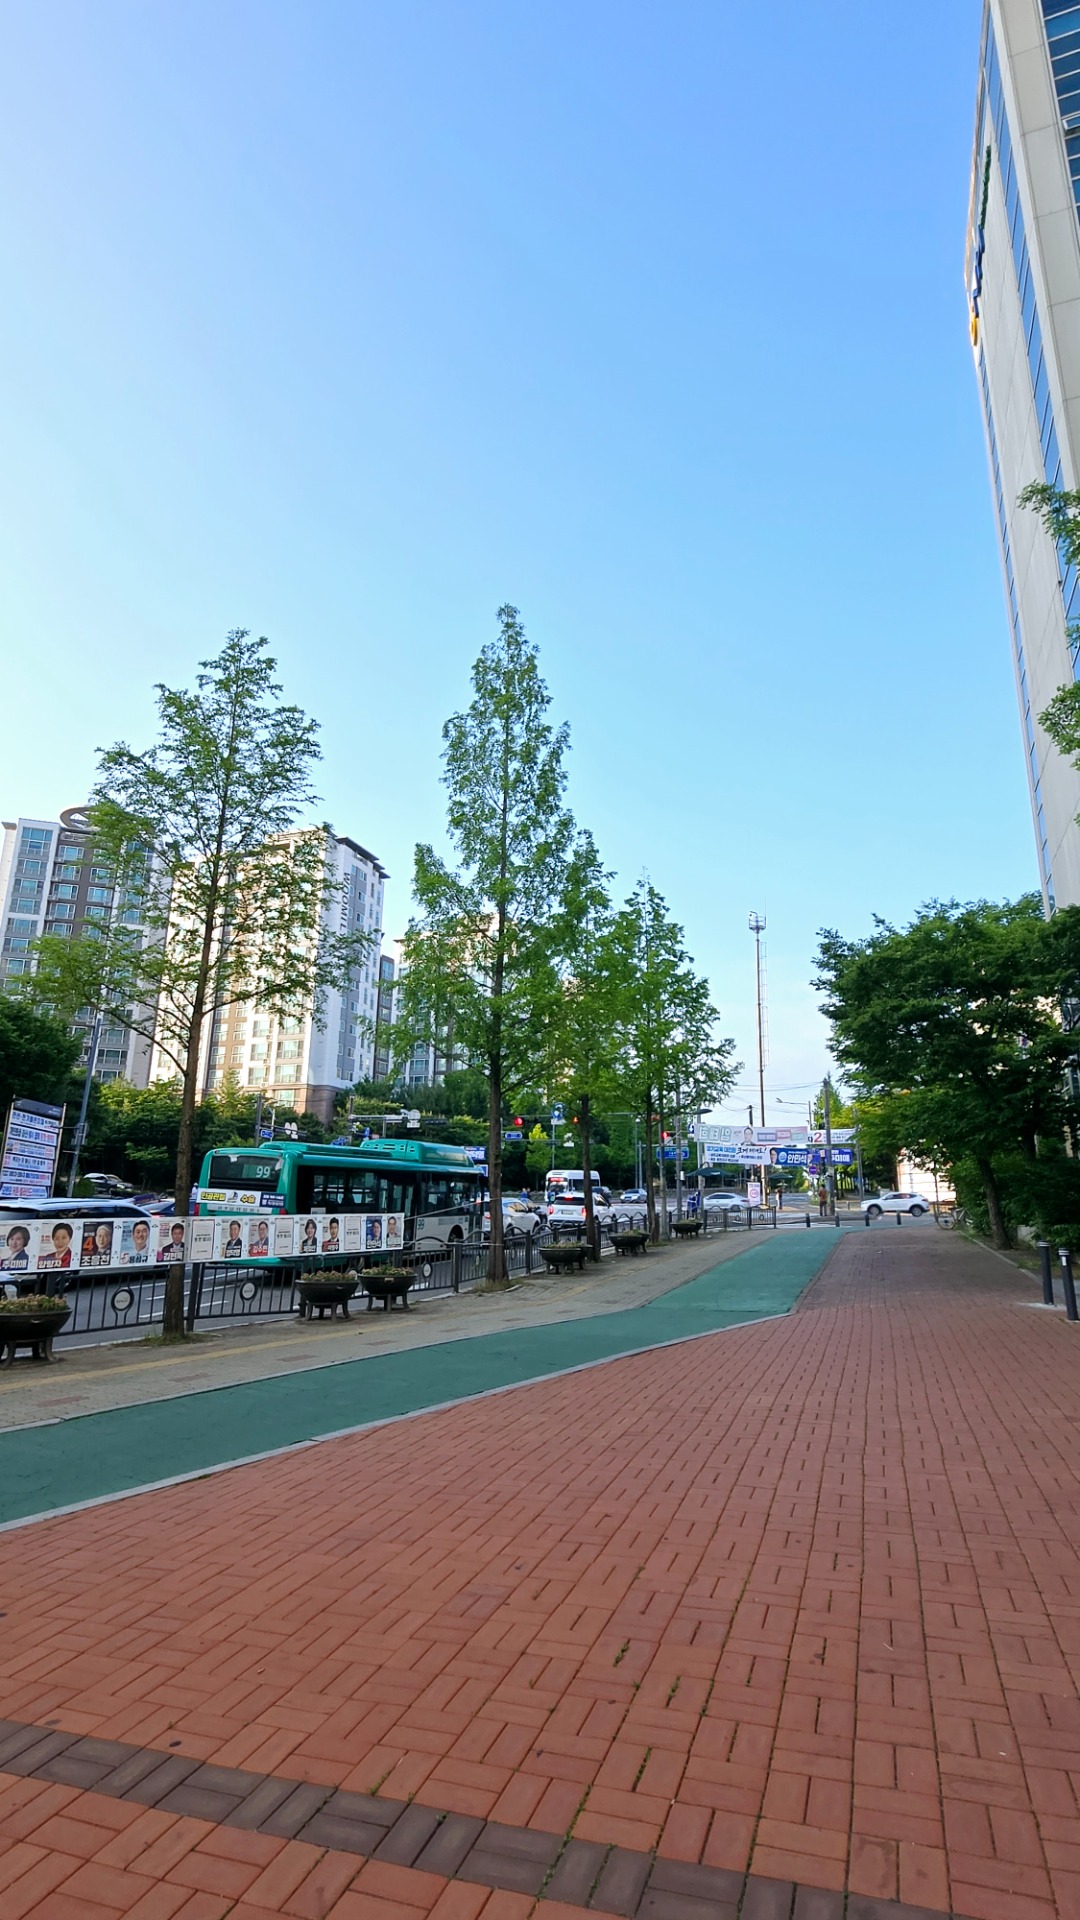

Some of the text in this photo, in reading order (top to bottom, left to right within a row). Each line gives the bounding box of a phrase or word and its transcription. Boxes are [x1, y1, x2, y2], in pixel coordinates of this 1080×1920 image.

[813, 1132, 823, 1142] 2
[256, 1166, 270, 1178] 99
[83, 1236, 94, 1250] 4
[81, 1255, 110, 1266] 조응천
